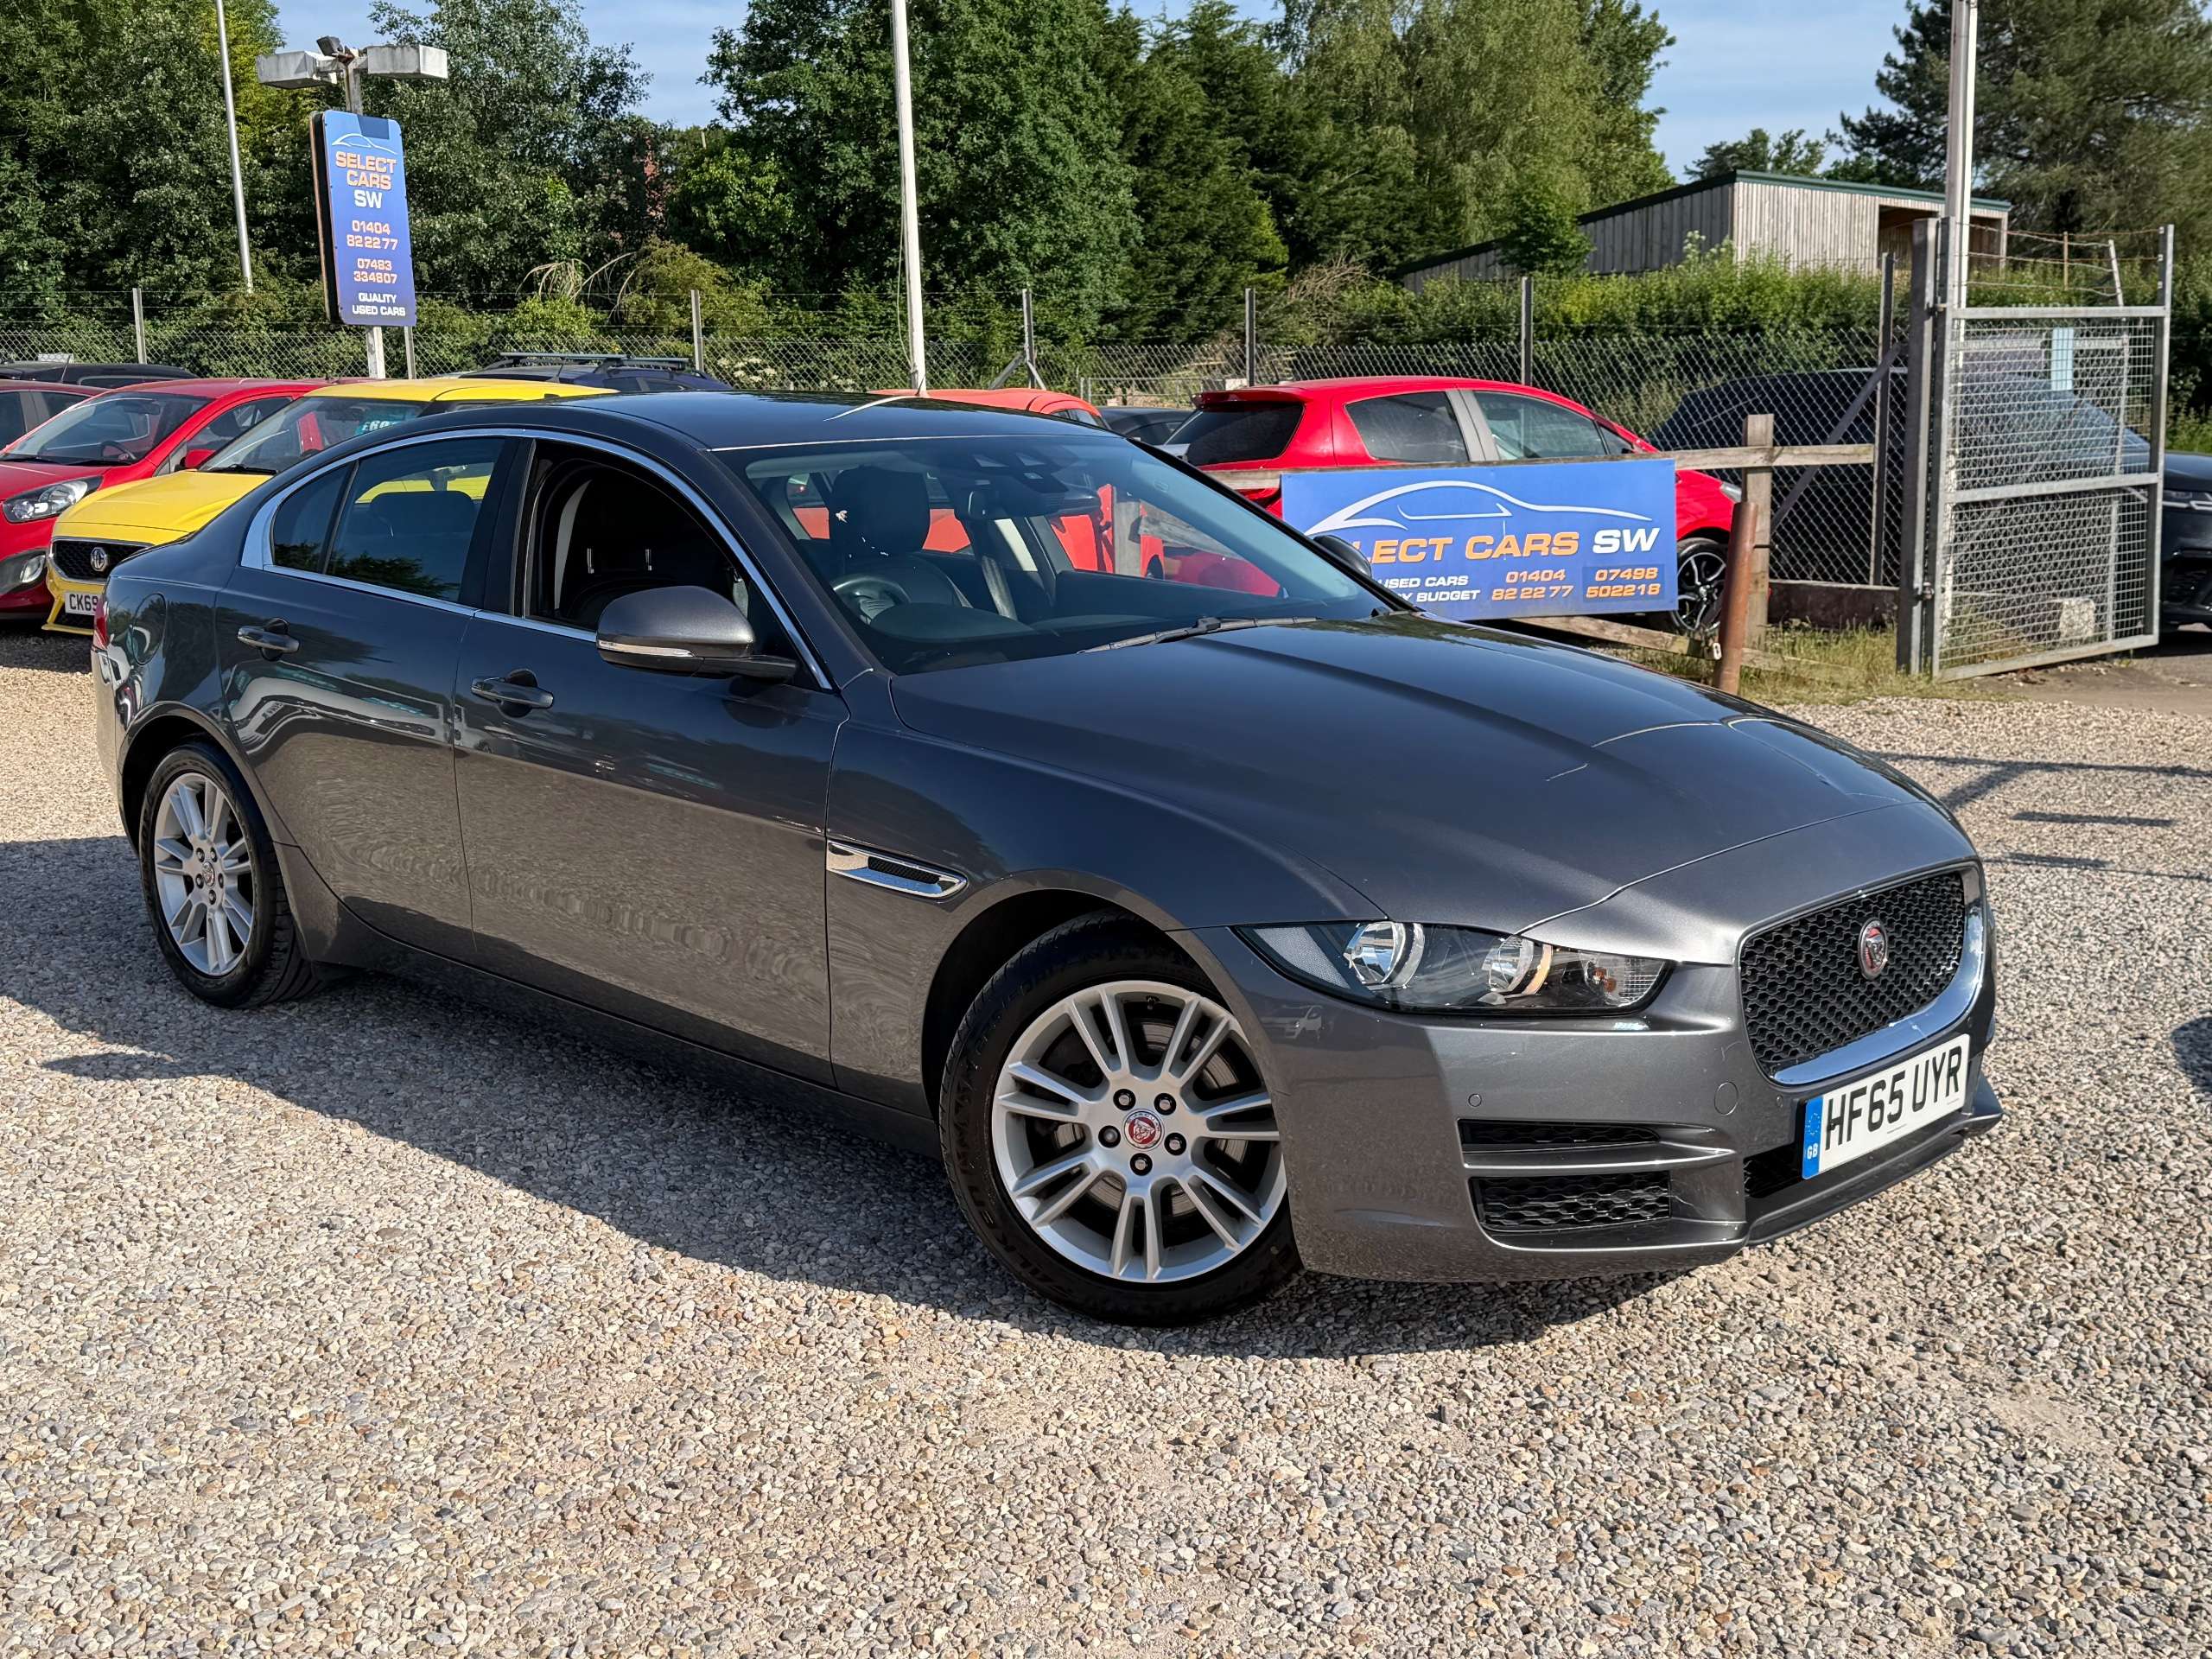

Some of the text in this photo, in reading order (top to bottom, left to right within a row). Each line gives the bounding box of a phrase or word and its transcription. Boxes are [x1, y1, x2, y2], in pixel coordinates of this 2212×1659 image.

[335, 151, 397, 174] SELECT
[346, 171, 391, 190] CARS
[354, 189, 383, 209] SW
[352, 219, 391, 236] 01404
[358, 292, 397, 304] QUALITY
[352, 305, 406, 317] USED CARS
[1465, 531, 1580, 561] CARS
[1592, 527, 1661, 555] SW
[1425, 575, 1469, 588] CARS
[1505, 569, 1567, 584] 01404
[1595, 567, 1659, 582] 07498
[1416, 590, 1481, 603] BUDGET
[1586, 583, 1661, 598] 502218
[1825, 1046, 1962, 1151] HF65 UYR
[1807, 1142, 1819, 1160] GB
